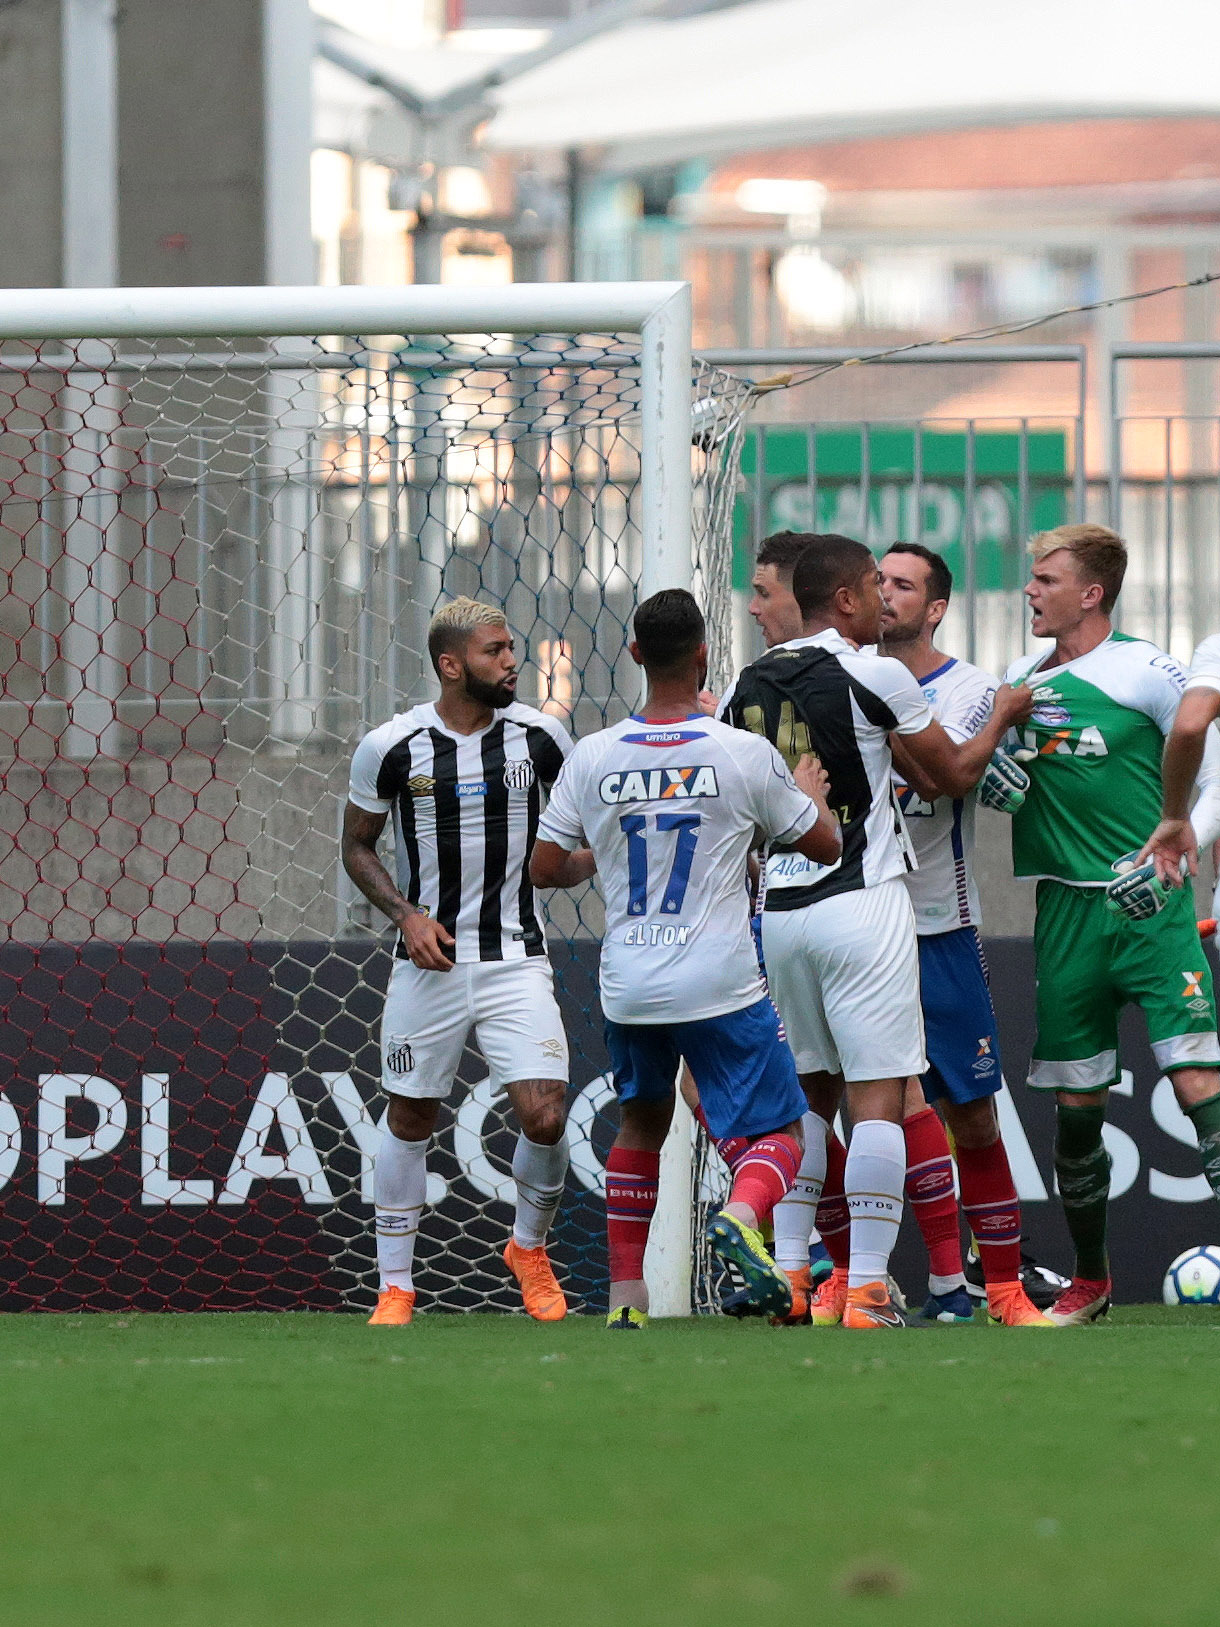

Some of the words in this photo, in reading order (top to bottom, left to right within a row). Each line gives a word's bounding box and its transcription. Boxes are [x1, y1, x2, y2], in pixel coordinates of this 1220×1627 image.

[645, 731, 681, 743] umbro
[599, 766, 719, 805] CAIXA
[619, 813, 701, 915] 17
[624, 923, 691, 947] ELTON
